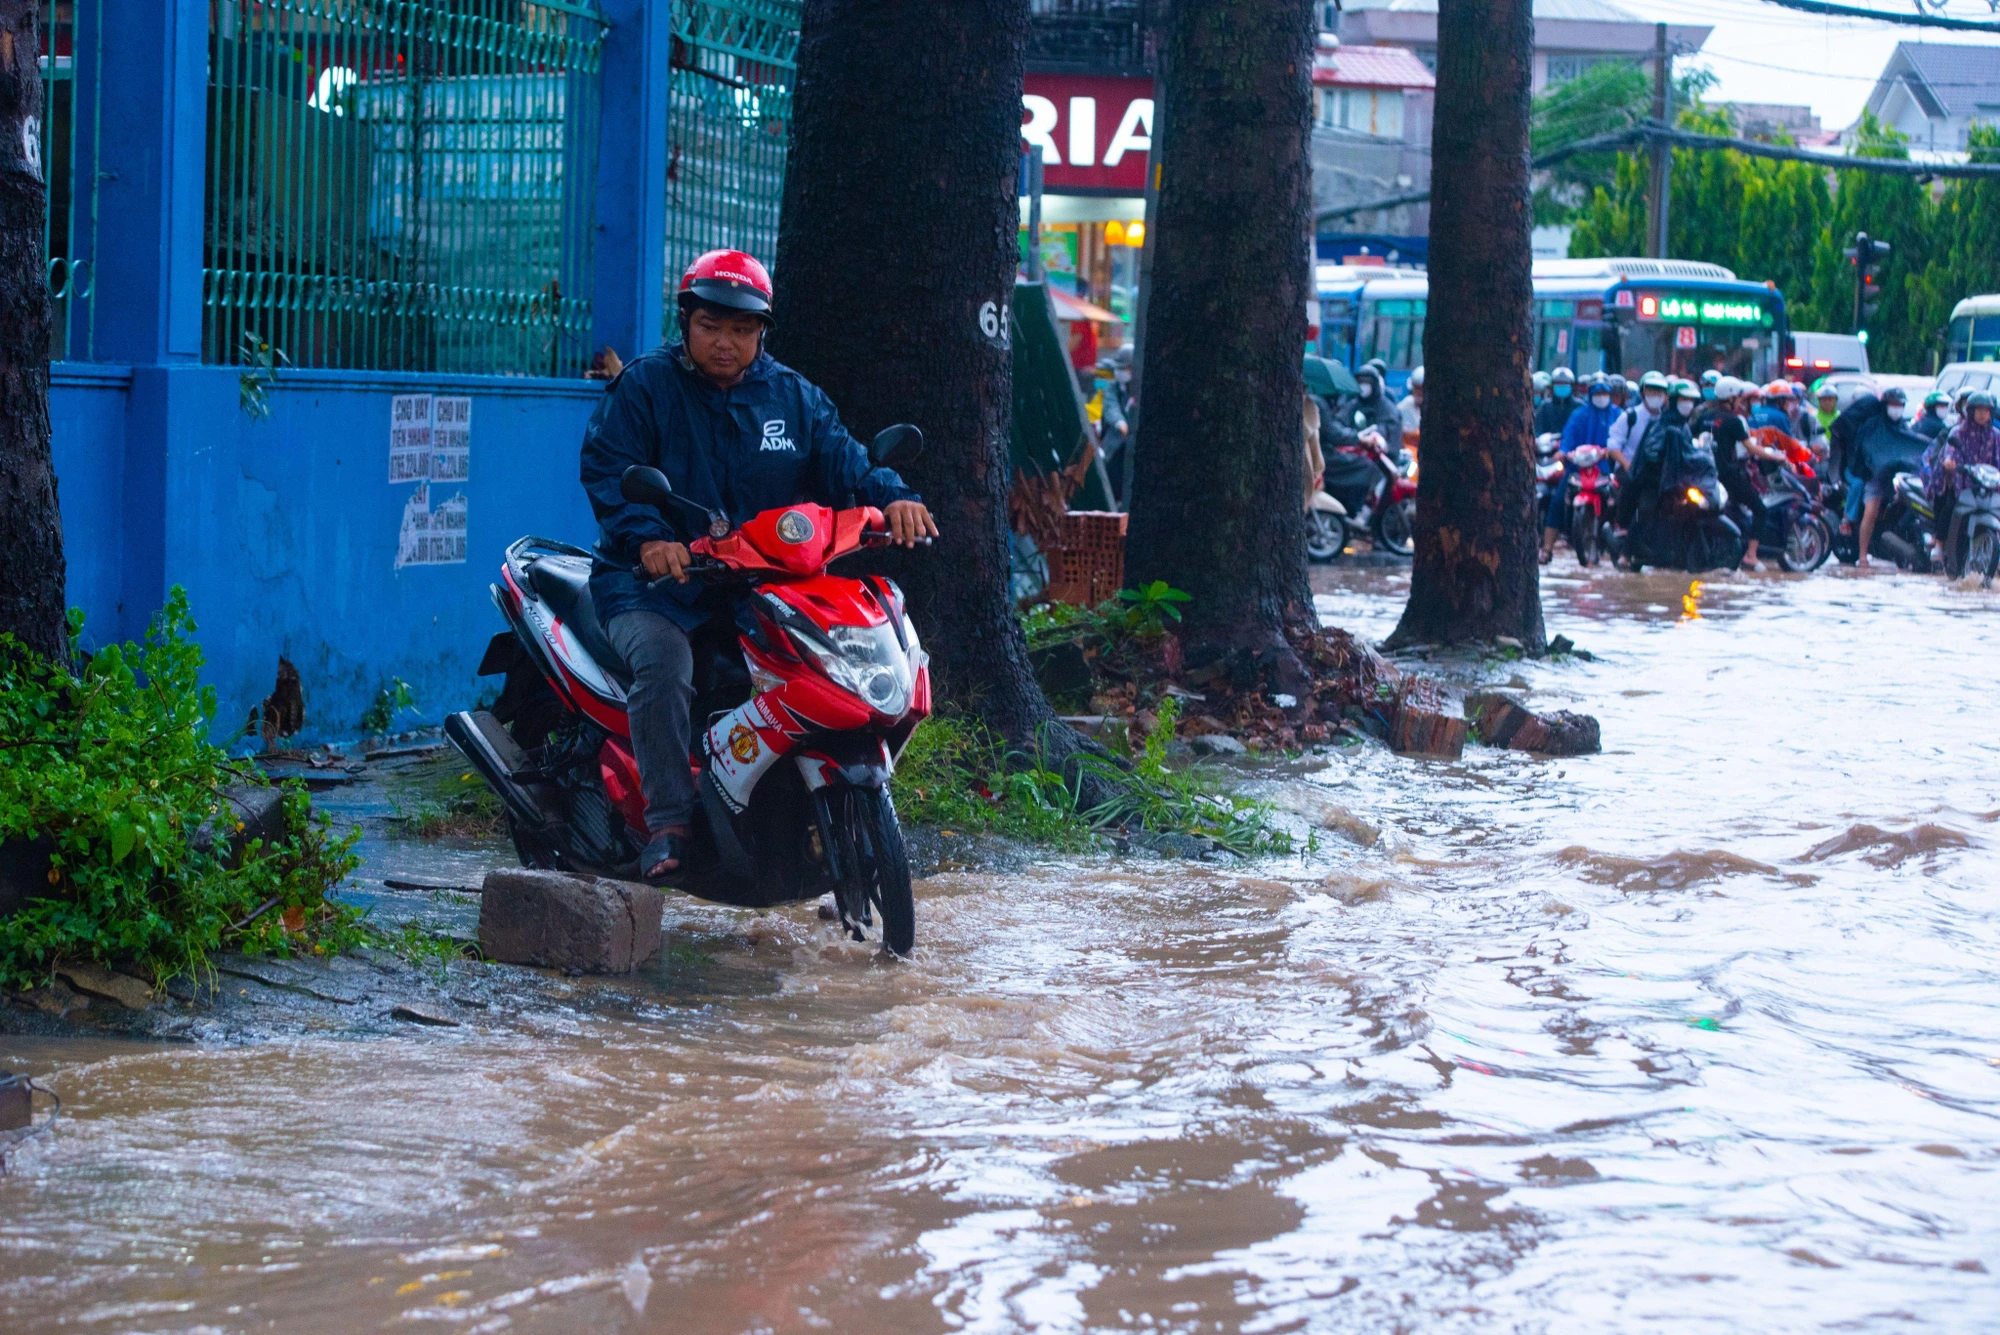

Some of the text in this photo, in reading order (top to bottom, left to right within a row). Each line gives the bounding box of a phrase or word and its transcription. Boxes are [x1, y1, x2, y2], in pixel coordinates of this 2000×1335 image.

[23, 115, 41, 168] 6
[1020, 94, 1155, 167] RIA
[714, 271, 753, 285] HONDA
[979, 300, 1008, 340] 65
[414, 398, 430, 420] VAY
[437, 400, 469, 422] CHO VAY
[760, 436, 796, 451] ADM
[525, 606, 558, 645] NOUVO
[756, 695, 783, 733] YAMAHA
